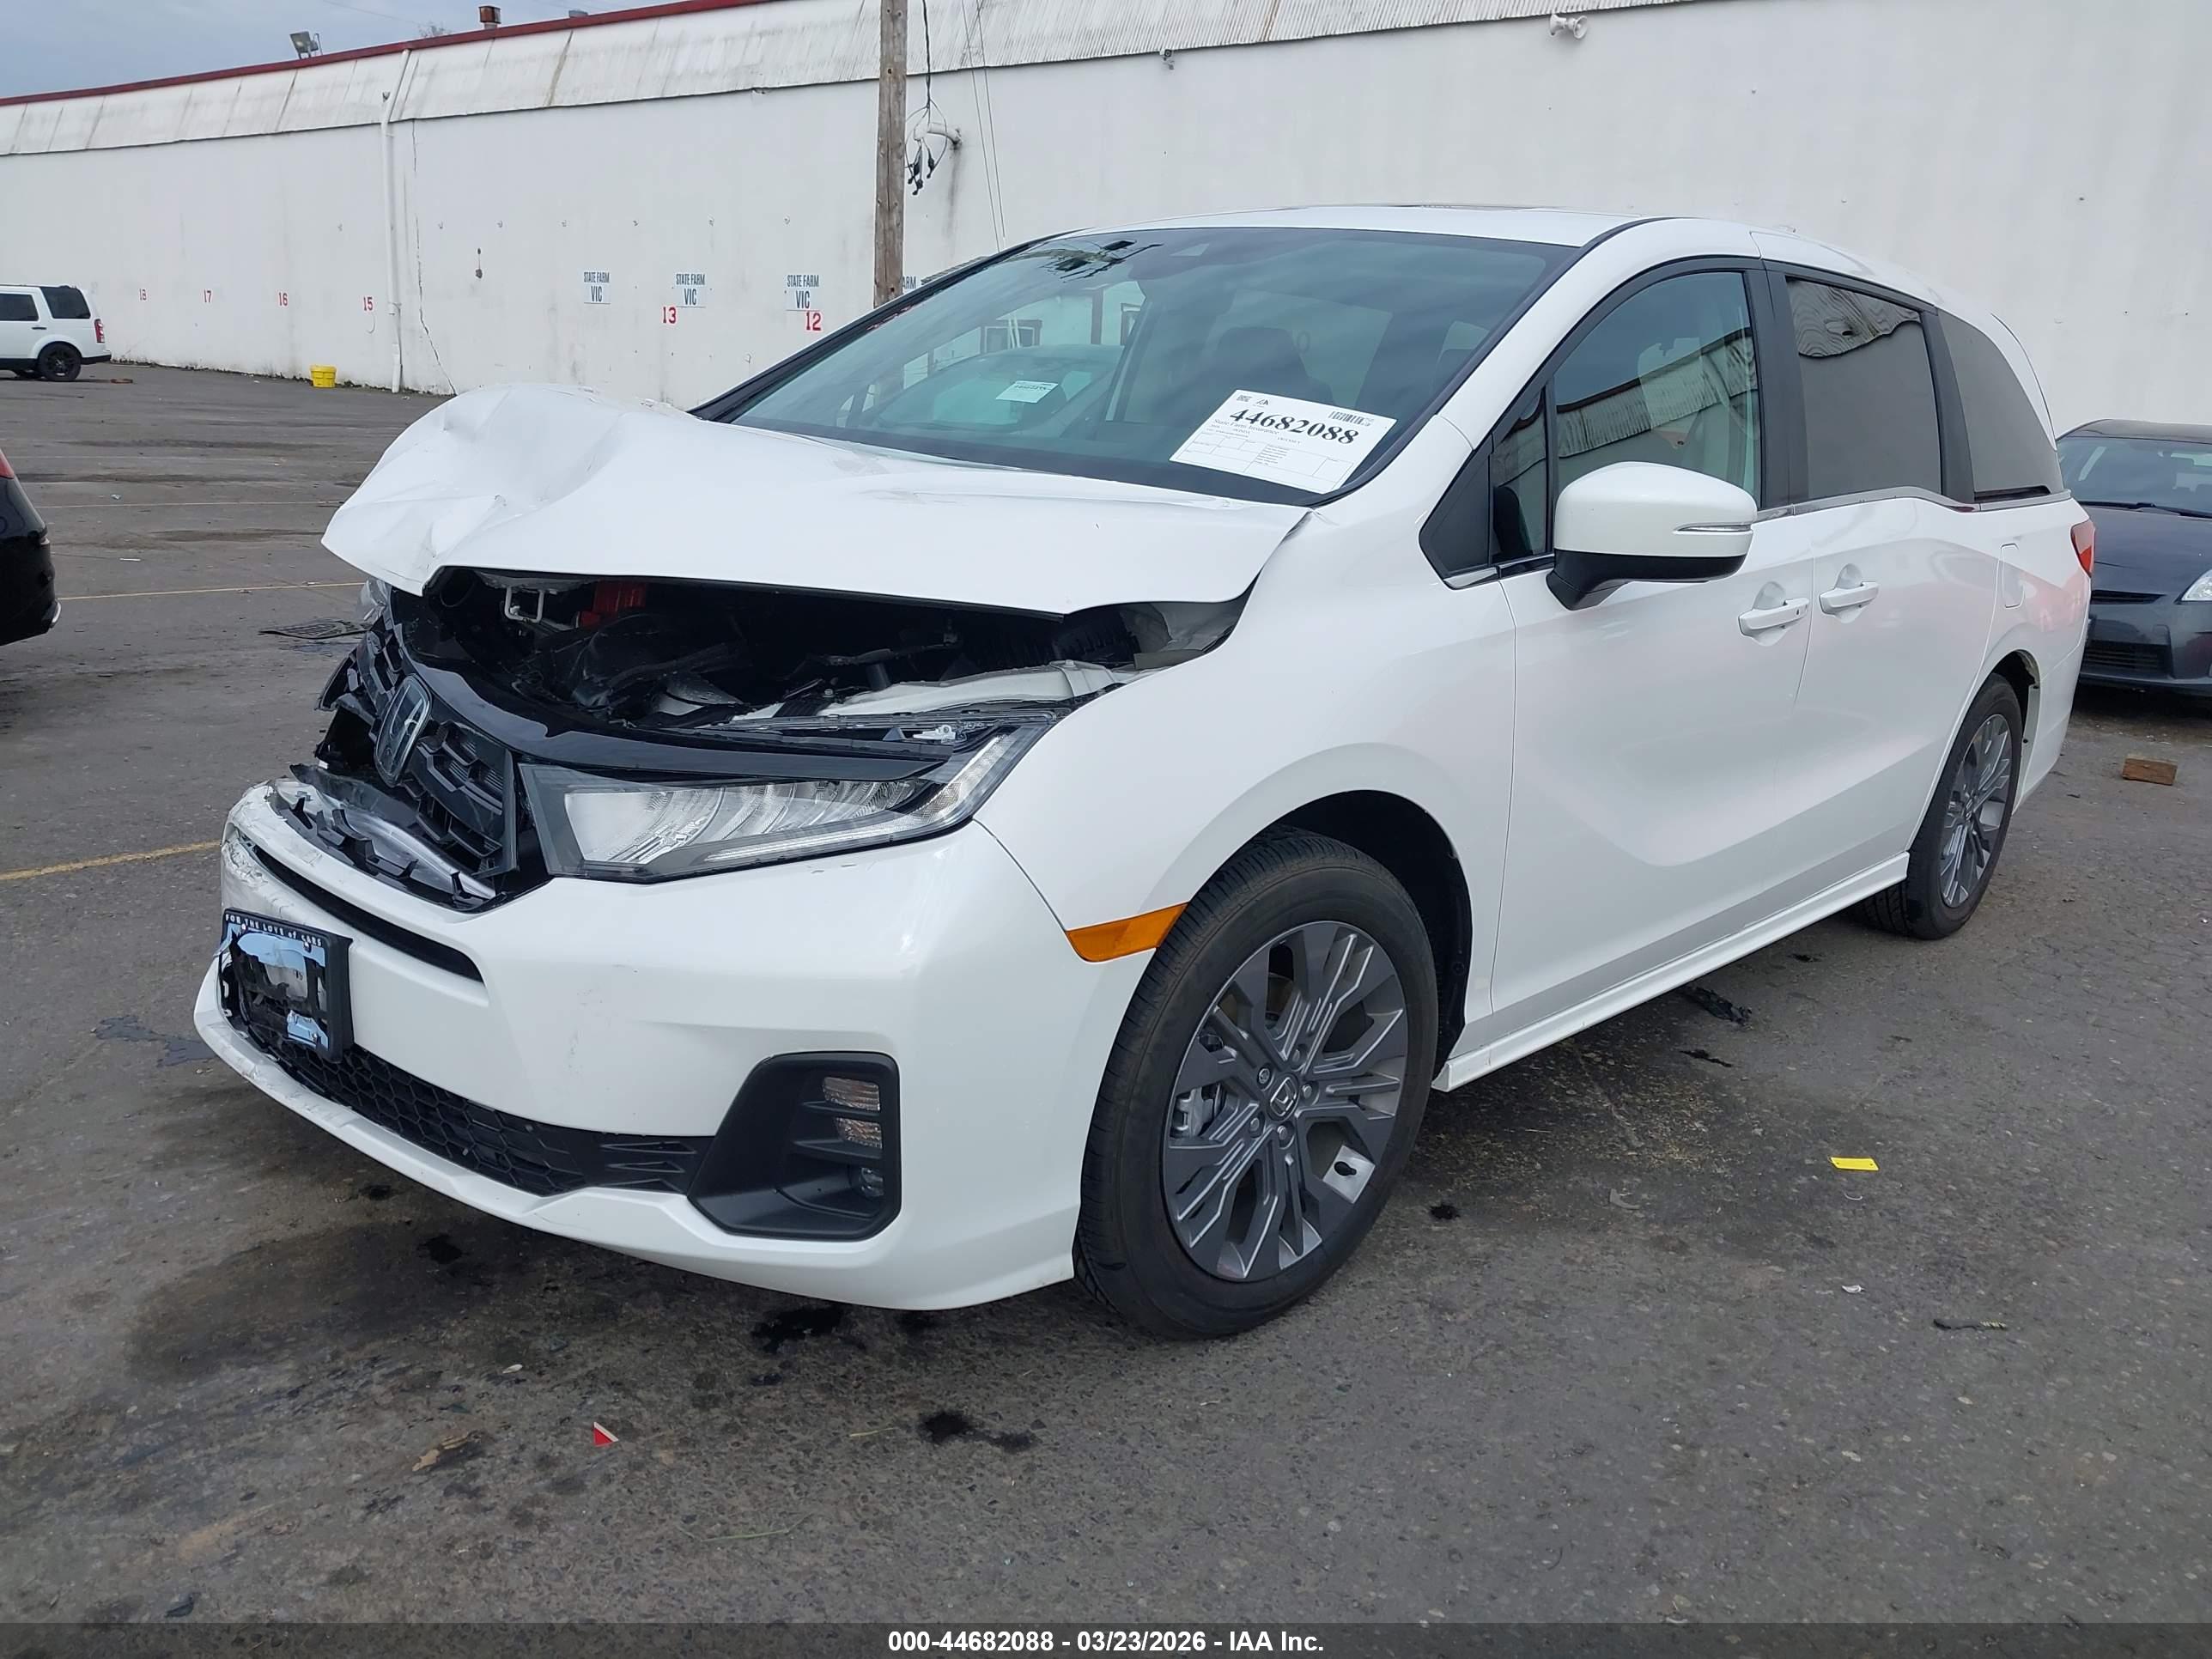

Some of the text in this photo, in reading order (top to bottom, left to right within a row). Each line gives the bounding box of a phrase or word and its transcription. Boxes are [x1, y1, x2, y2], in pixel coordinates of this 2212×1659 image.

[584, 272, 610, 283] STATE FARM
[676, 274, 705, 285] STATE FARM
[787, 275, 819, 288] STATE FARM
[902, 276, 916, 289] ARM
[204, 289, 212, 303] 17
[278, 292, 289, 307] 16
[591, 286, 603, 302] VIC
[684, 289, 697, 306] VIC
[795, 290, 811, 309] VIC
[363, 296, 374, 311] 15
[662, 307, 677, 325] 13
[805, 311, 822, 331] 12
[1230, 409, 1359, 445] 44682088
[225, 914, 240, 923] FOR
[244, 918, 259, 928] THE
[263, 923, 284, 936] LOVE
[301, 934, 322, 947] CARS
